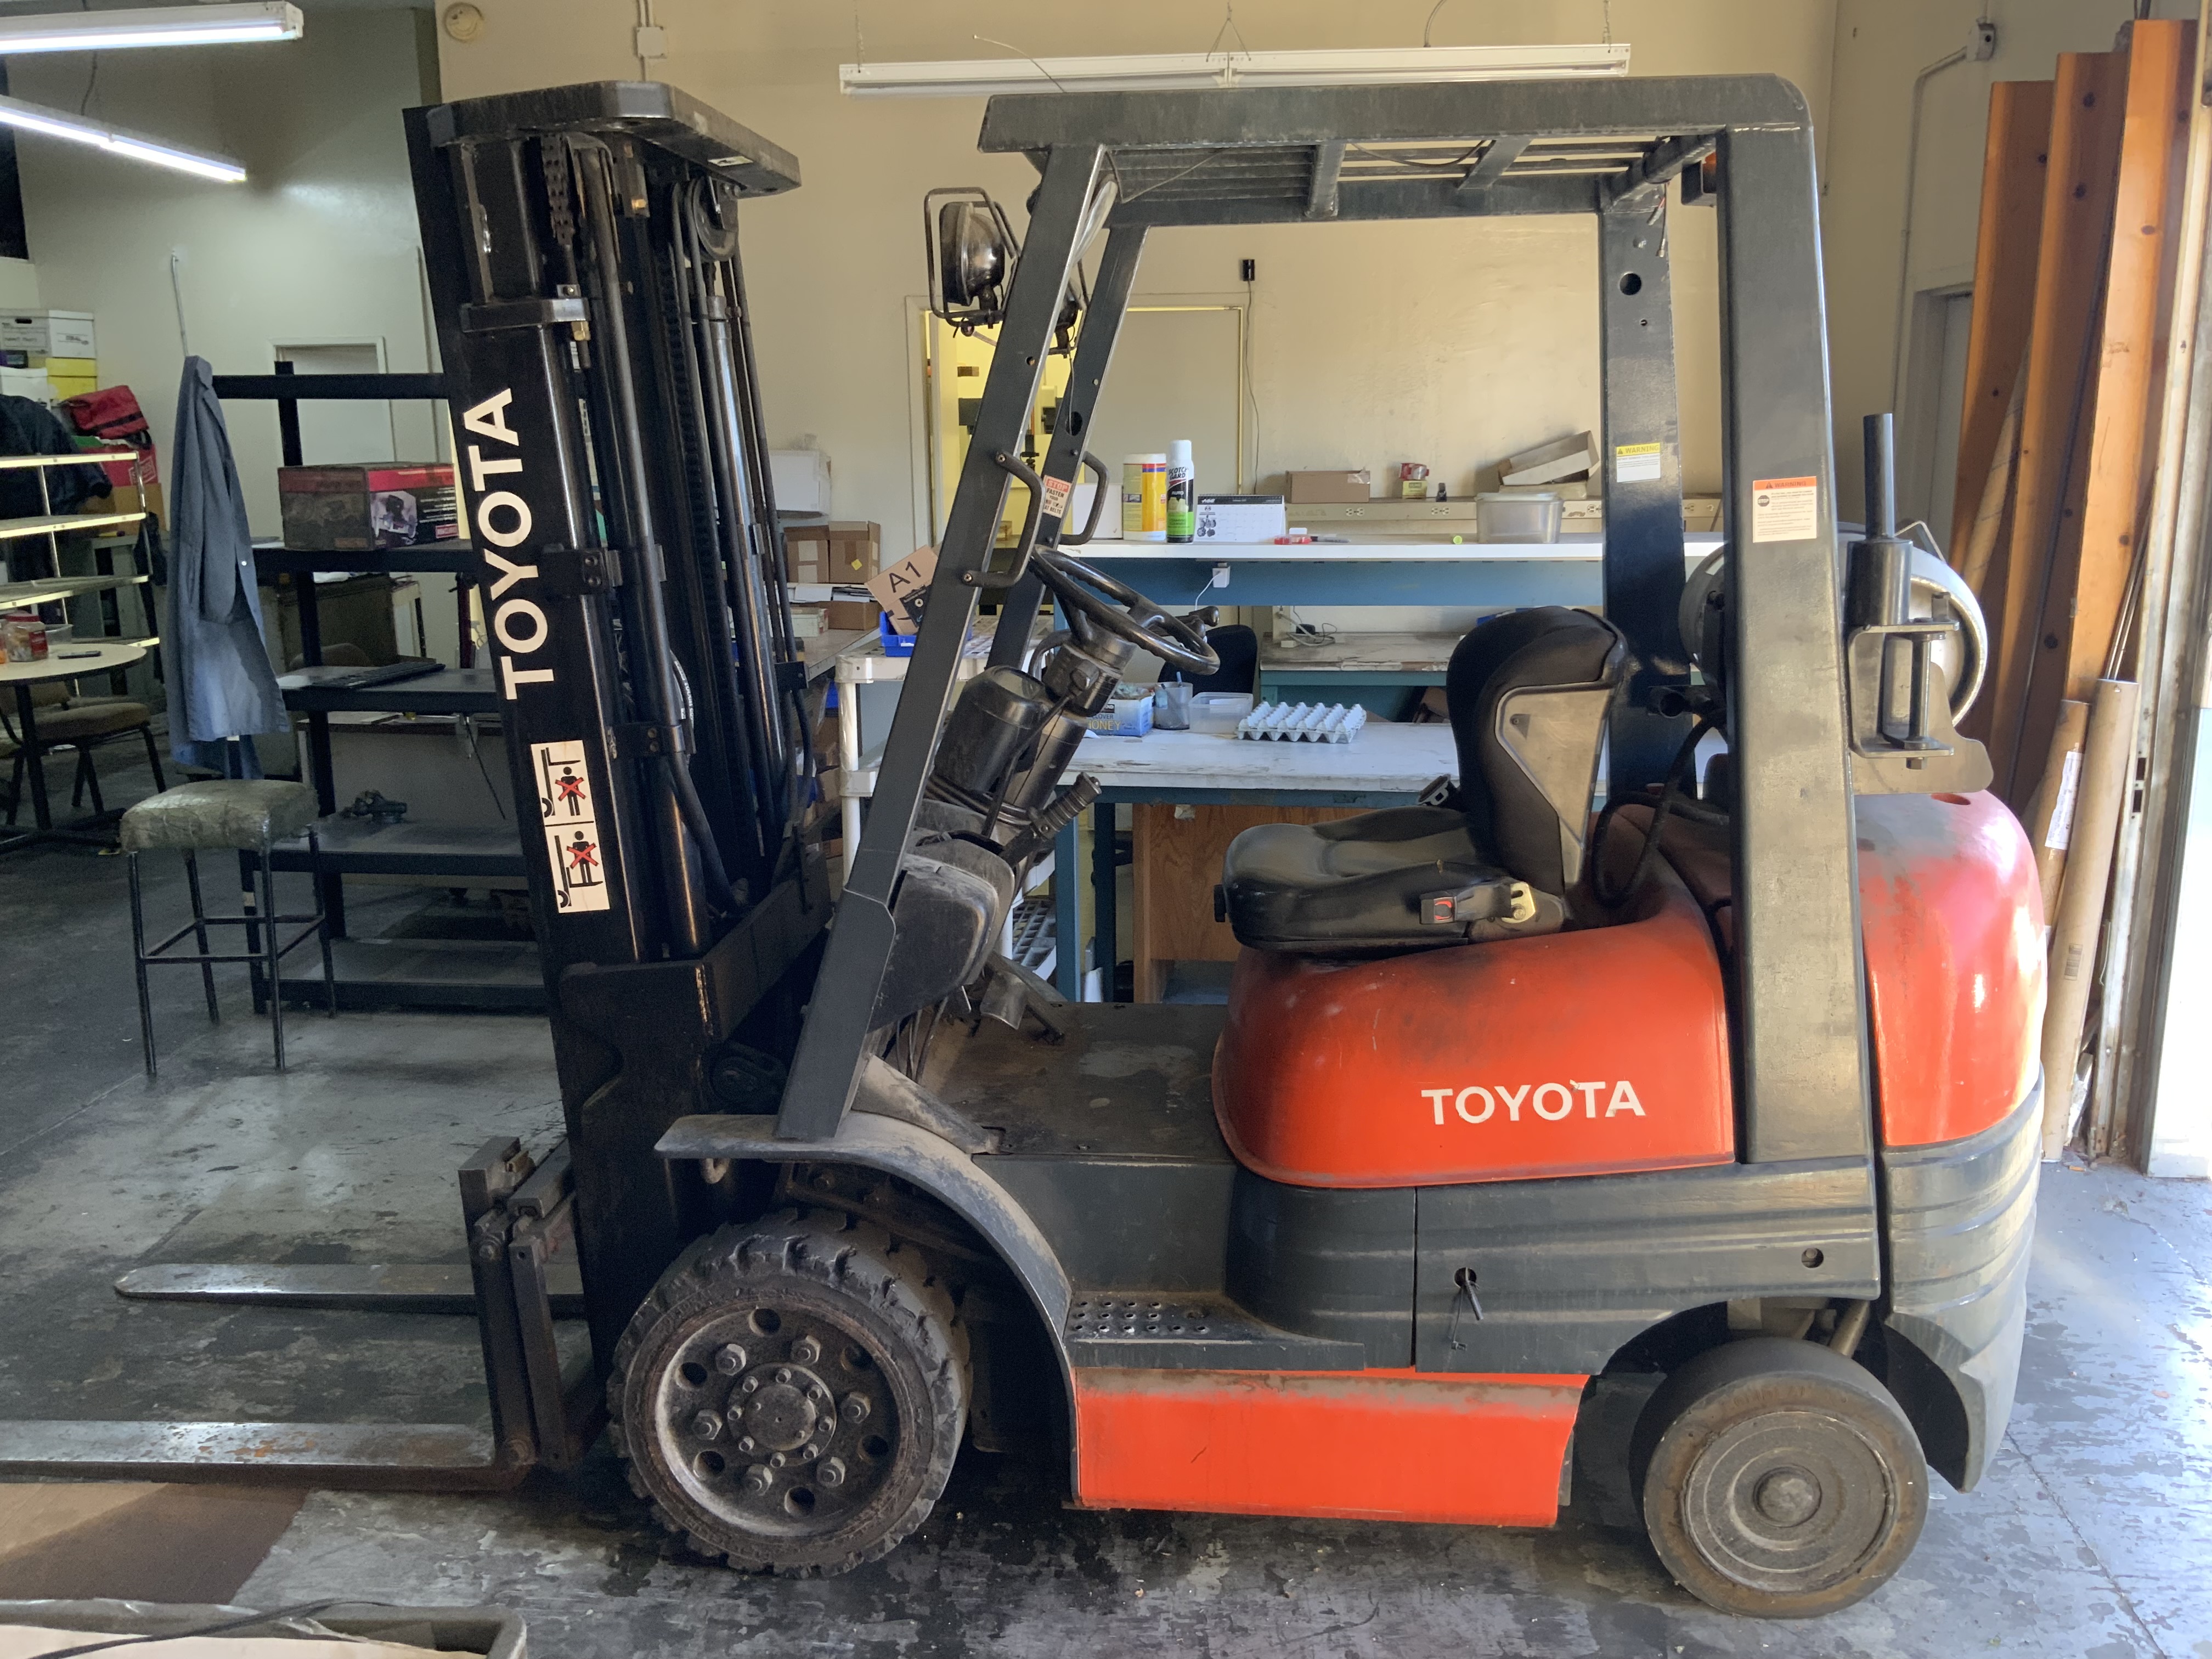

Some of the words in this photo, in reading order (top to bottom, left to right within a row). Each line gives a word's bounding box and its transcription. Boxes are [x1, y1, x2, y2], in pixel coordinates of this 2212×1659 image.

[1625, 445, 1659, 454] WARNING
[1048, 480, 1068, 491] STOP
[1046, 488, 1064, 498] FASTEN
[464, 388, 555, 700] TOYOTA
[1421, 1080, 1646, 1125] TOYOTA
